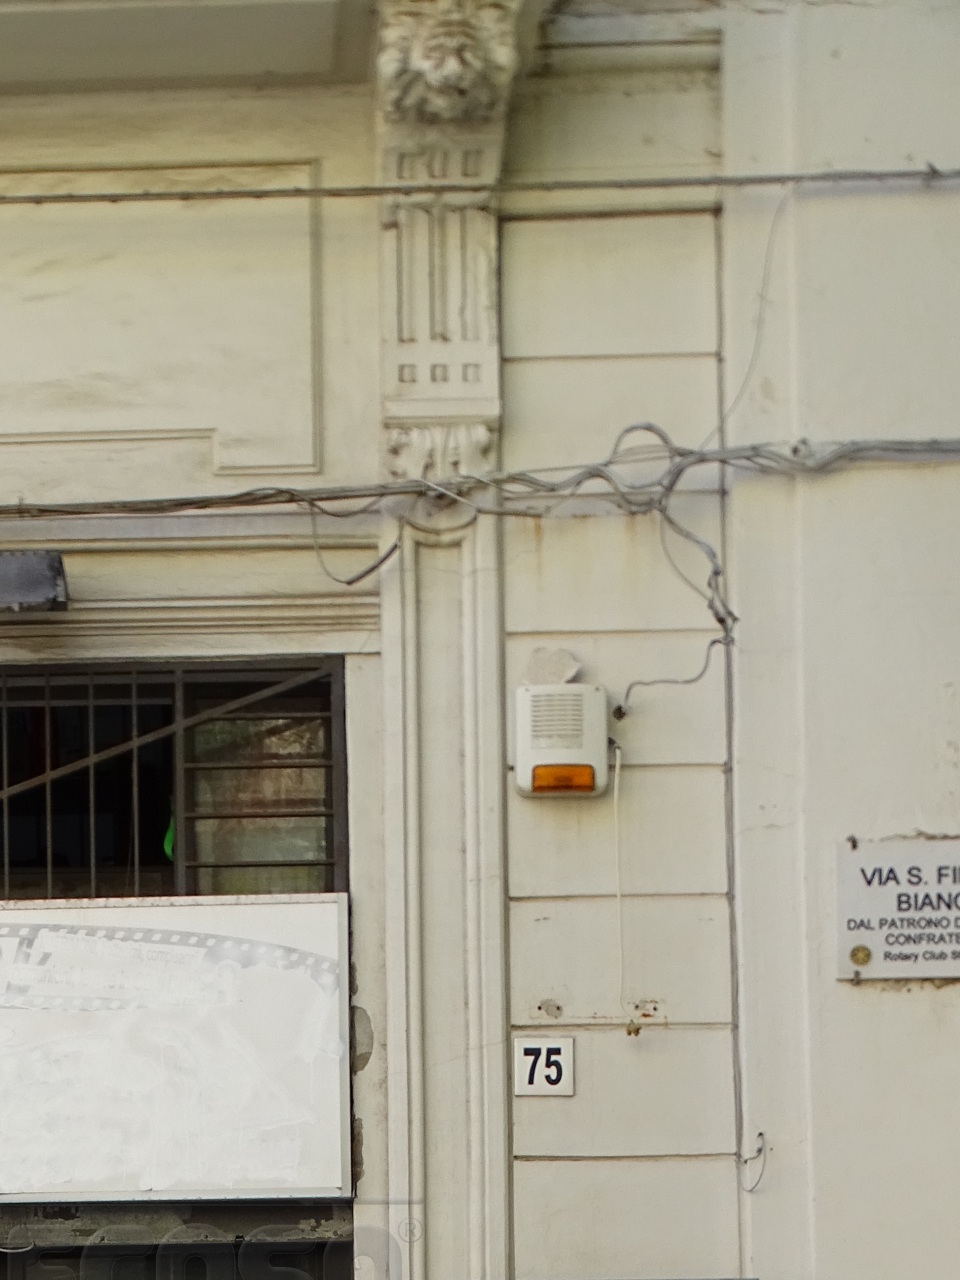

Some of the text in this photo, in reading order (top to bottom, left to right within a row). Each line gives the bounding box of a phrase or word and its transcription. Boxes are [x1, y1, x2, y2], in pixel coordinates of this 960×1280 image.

[860, 866, 960, 886] VIA S. FI
[847, 918, 875, 931] DAL
[879, 916, 950, 930] PATRONO
[884, 950, 918, 963] Rotary
[922, 950, 948, 961] Club
[523, 1047, 563, 1086] 75
